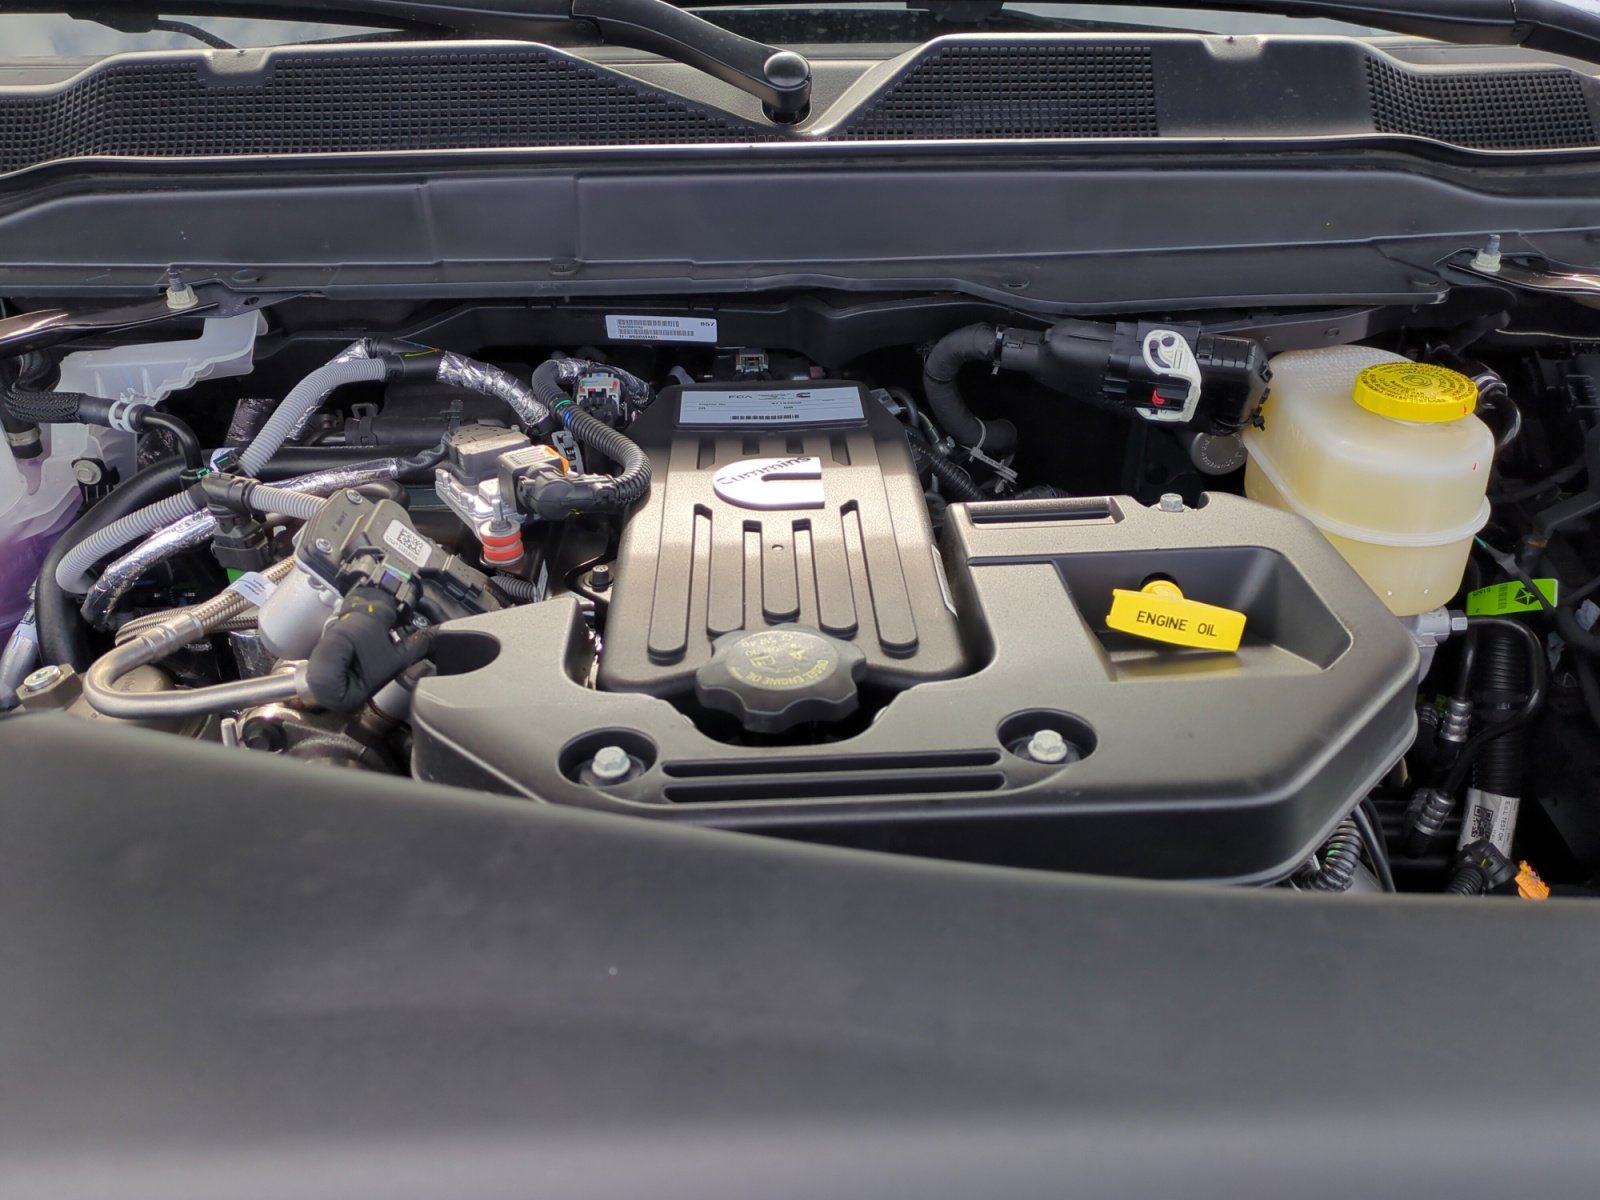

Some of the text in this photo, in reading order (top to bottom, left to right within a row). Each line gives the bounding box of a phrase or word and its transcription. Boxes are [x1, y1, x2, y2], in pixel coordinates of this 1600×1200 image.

[716, 456, 812, 485] Cummins
[1136, 610, 1218, 637] ENGINE OIL
[1500, 817, 1508, 832] TEST
